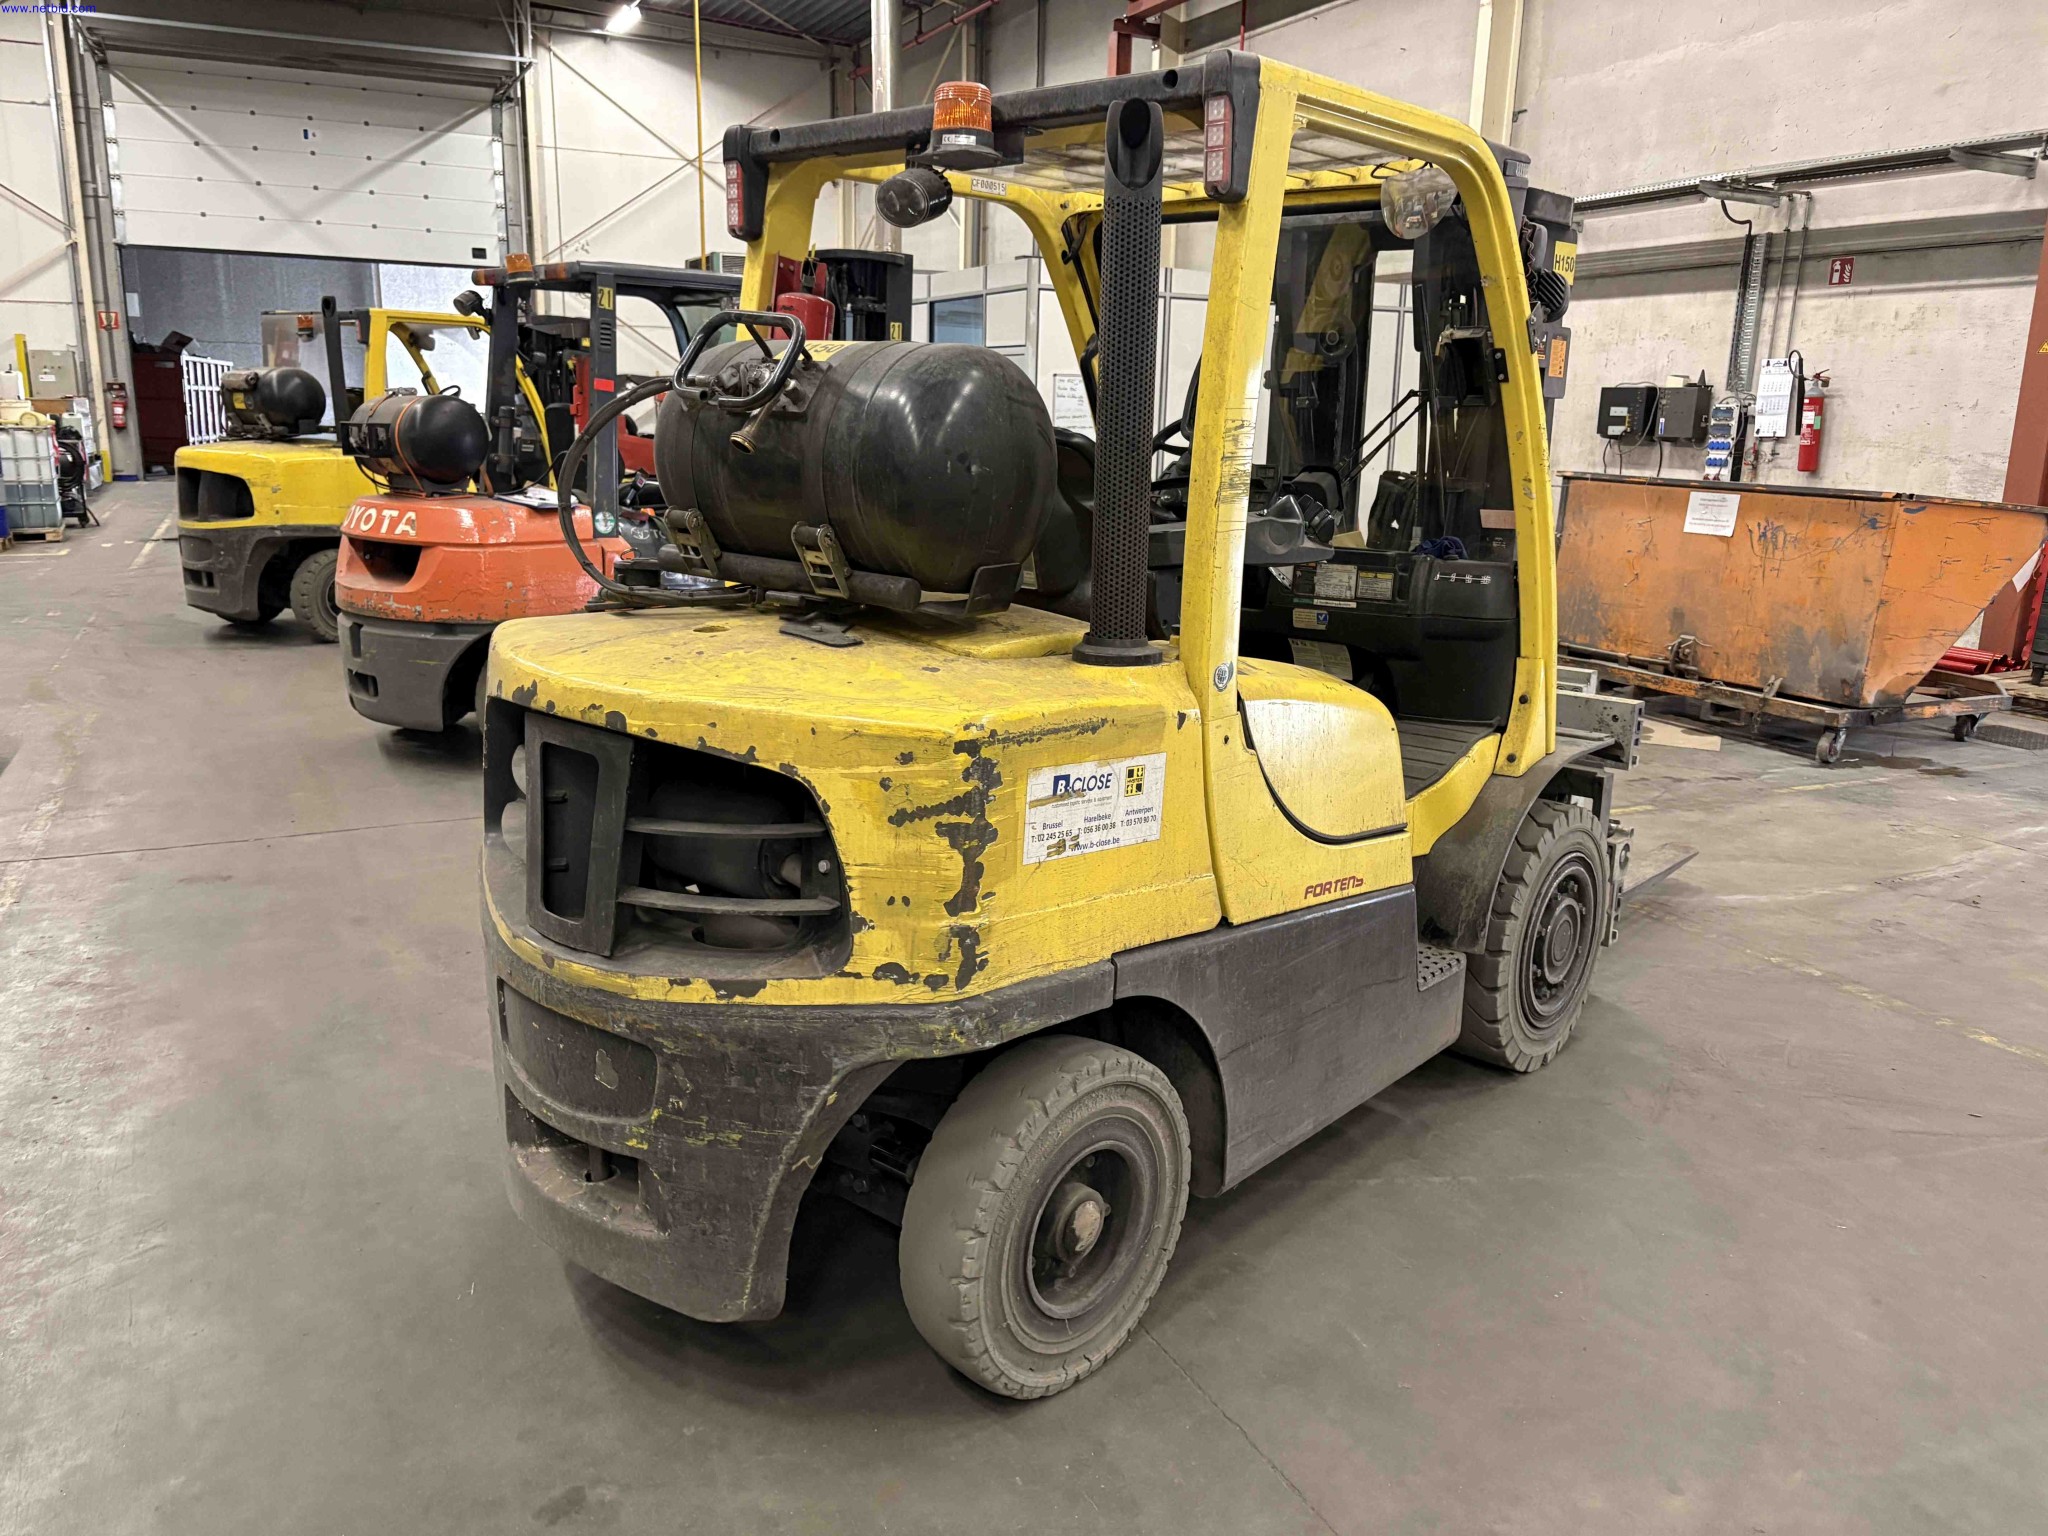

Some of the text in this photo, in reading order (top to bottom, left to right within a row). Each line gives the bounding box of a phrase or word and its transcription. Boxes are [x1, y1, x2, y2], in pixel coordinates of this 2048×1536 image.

[1554, 254, 1575, 272] H150
[599, 289, 611, 308] 21
[891, 324, 901, 340] 21
[1125, 806, 1154, 817] Antwerpen
[1083, 812, 1112, 823] Harelbeke
[1133, 816, 1143, 826] 570
[1042, 820, 1064, 831] Brussel
[1083, 826, 1094, 834] 056
[1101, 823, 1109, 831] 00
[1037, 833, 1045, 842] 02
[1045, 832, 1057, 841] 245
[1057, 830, 1065, 839] 25
